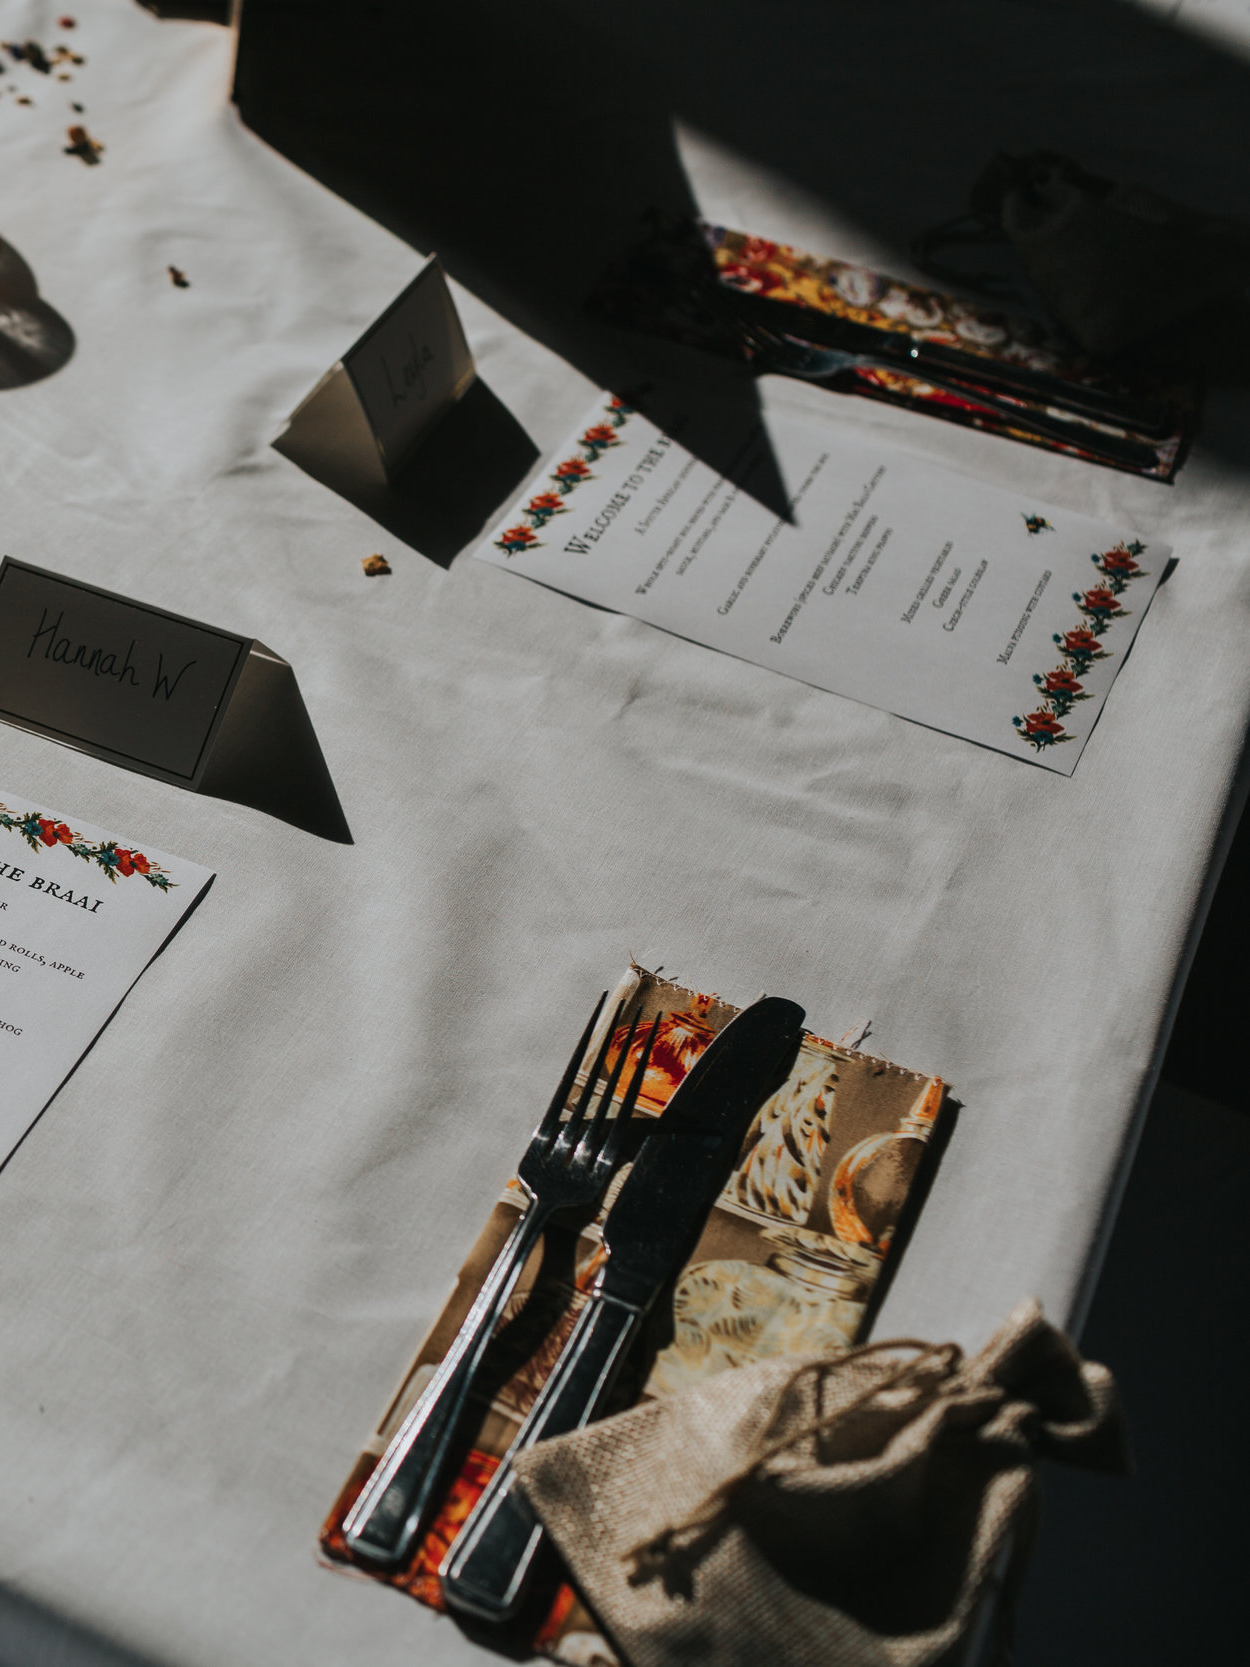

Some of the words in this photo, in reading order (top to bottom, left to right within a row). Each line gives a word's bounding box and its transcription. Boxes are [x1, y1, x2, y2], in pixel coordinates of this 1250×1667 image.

[563, 492, 630, 554] WELCOME
[621, 474, 643, 490] TO
[28, 608, 139, 686] Hannah
[152, 653, 197, 700] W
[27, 876, 105, 914] BRAAI
[8, 943, 47, 967] ROLLS,
[48, 961, 86, 980] APPLE
